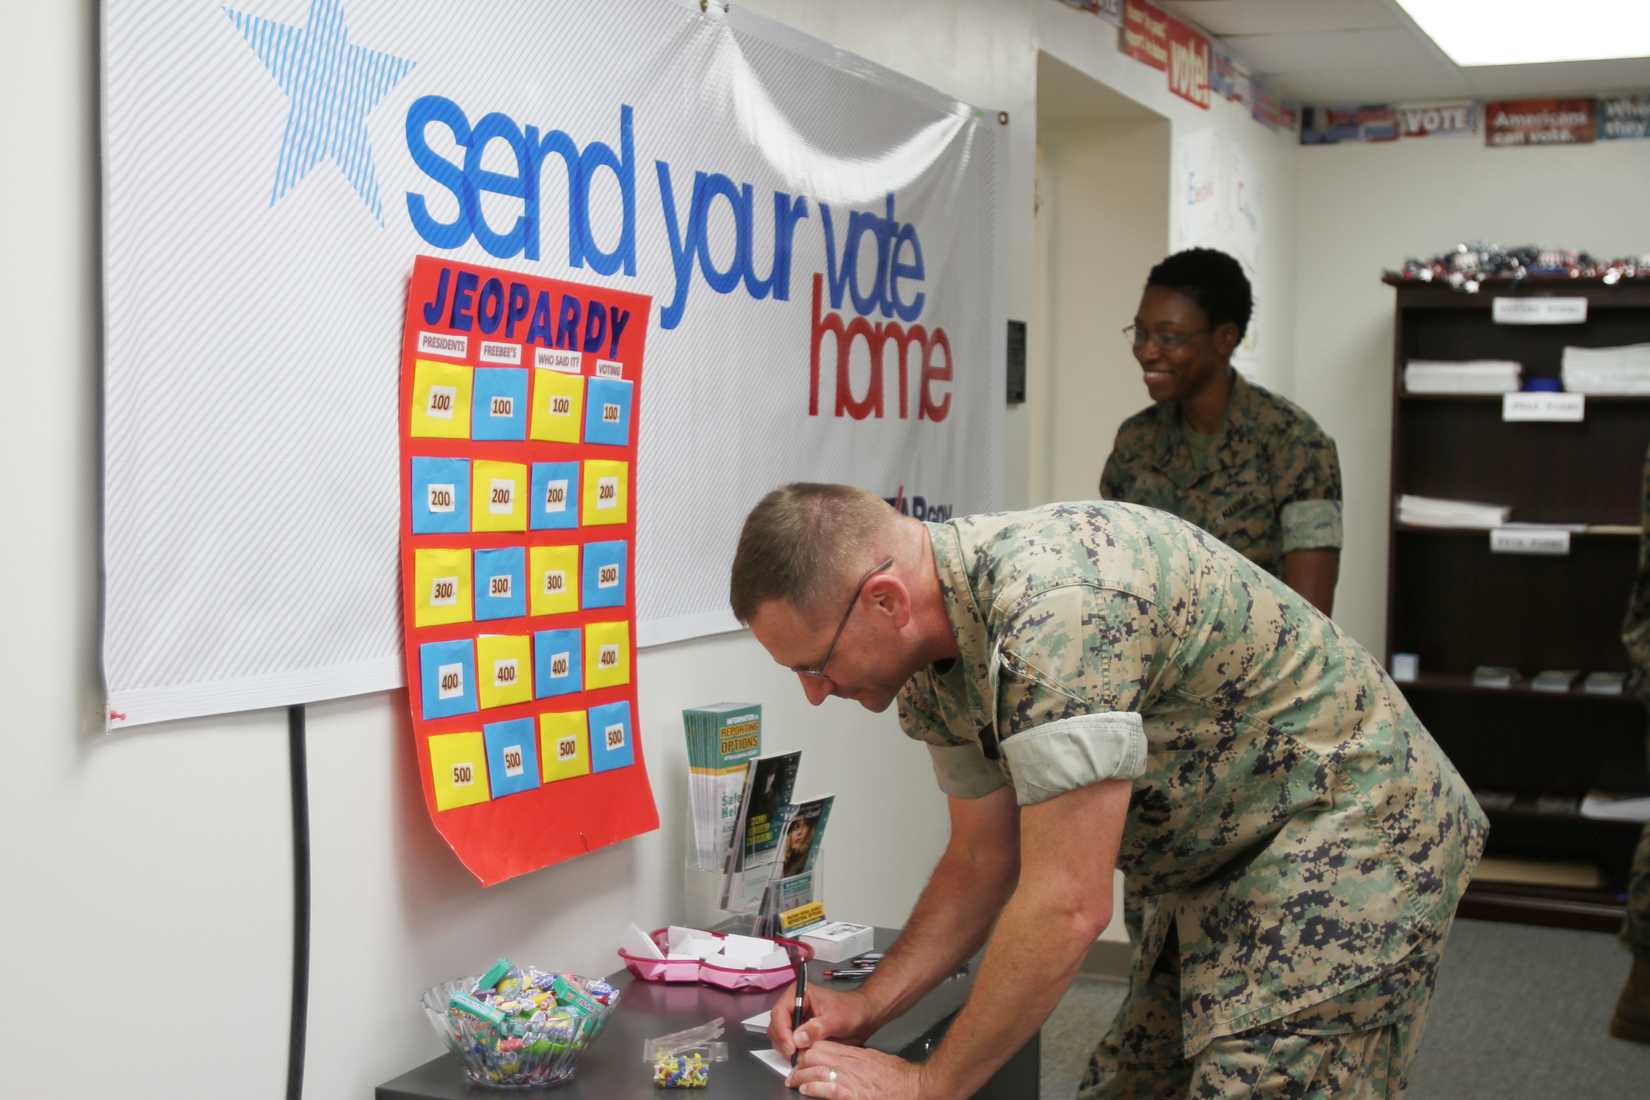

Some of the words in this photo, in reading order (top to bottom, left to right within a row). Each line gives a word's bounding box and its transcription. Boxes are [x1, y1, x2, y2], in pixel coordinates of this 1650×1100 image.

[1407, 110, 1467, 132] VOTE
[405, 95, 636, 277] send
[655, 159, 809, 330] your
[819, 193, 925, 322] vote
[423, 268, 630, 359] JEOPARDY
[422, 336, 465, 352] PRESIDENTS
[809, 273, 953, 423] home
[538, 355, 554, 364] WHO
[555, 357, 569, 366] SAID
[599, 364, 620, 375] VOTING
[431, 394, 450, 410] 100
[493, 400, 511, 414] 100
[553, 398, 569, 413] 100
[604, 406, 618, 420] 100
[432, 490, 450, 506] 200
[492, 488, 510, 504] 200
[547, 488, 563, 503] 200
[600, 484, 614, 499] 200
[547, 576, 562, 589] 300
[600, 568, 616, 583] 300
[435, 583, 453, 598] 300
[491, 579, 508, 594] 300
[601, 650, 615, 664] 400
[498, 666, 515, 681] 400
[552, 659, 566, 674] 400
[442, 674, 458, 690] 400
[720, 721, 758, 736] REPORTING
[608, 730, 622, 745] 500
[721, 736, 757, 753] OPTIONS
[559, 741, 575, 756] 500
[505, 753, 520, 768] 500
[453, 768, 471, 783] 500
